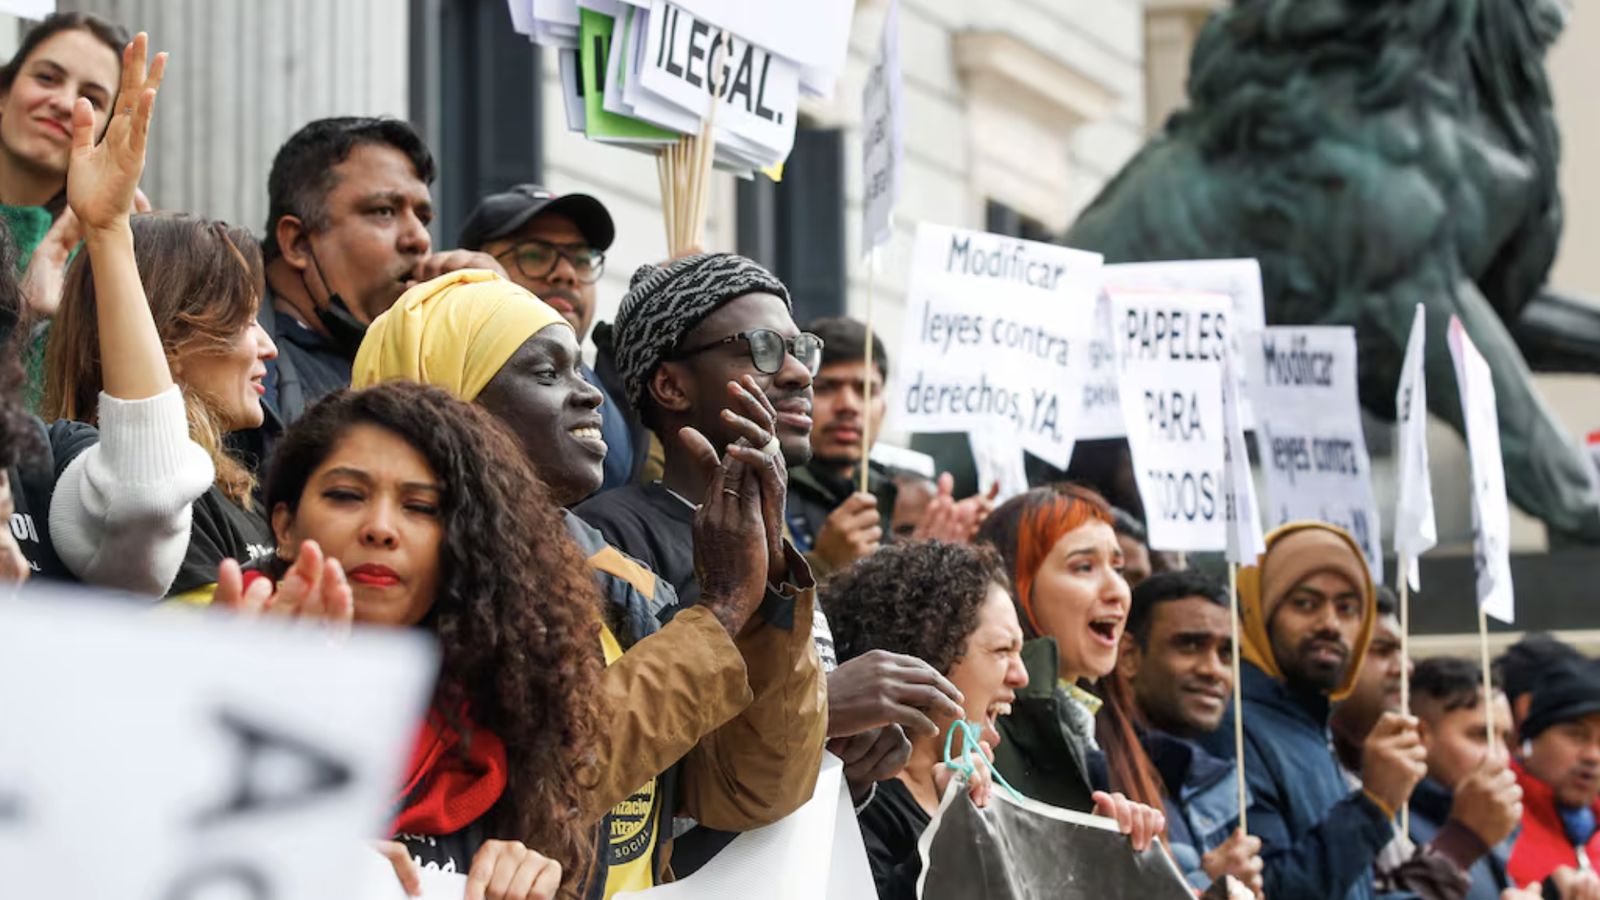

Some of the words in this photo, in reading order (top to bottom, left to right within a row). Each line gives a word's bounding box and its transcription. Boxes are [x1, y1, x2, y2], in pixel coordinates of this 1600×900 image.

[656, 3, 783, 125] ILEGAL.
[947, 234, 1066, 290] Modificar
[921, 299, 983, 356] leyes
[991, 317, 1070, 367] contra
[1126, 309, 1226, 361] PAPELES
[1144, 389, 1207, 440] PARA
[614, 829, 650, 858] SOCIAL
